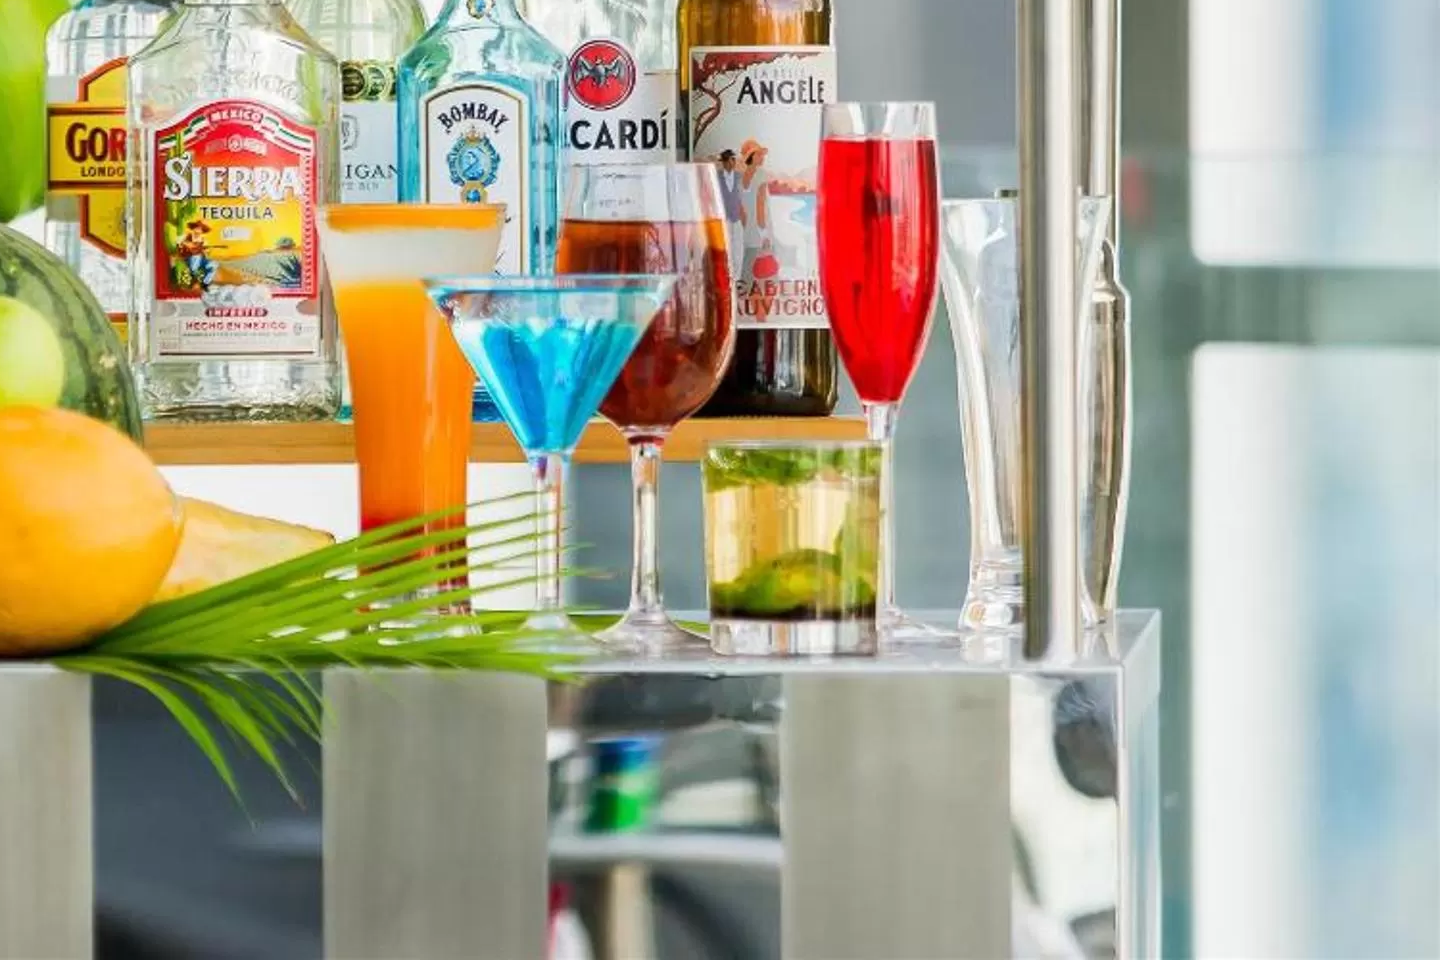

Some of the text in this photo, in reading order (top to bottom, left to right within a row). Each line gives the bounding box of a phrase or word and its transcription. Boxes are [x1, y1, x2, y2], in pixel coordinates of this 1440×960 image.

[737, 76, 825, 105] ANGELE
[210, 108, 264, 123] MEXICO
[437, 102, 510, 134] BOMBAY
[563, 109, 670, 151] CARDÍ
[164, 153, 302, 201] SIERRA
[200, 206, 274, 220] TEQUILA
[185, 321, 225, 331] HECHO
[227, 321, 242, 330] EN
[244, 320, 288, 330] MEXICO
